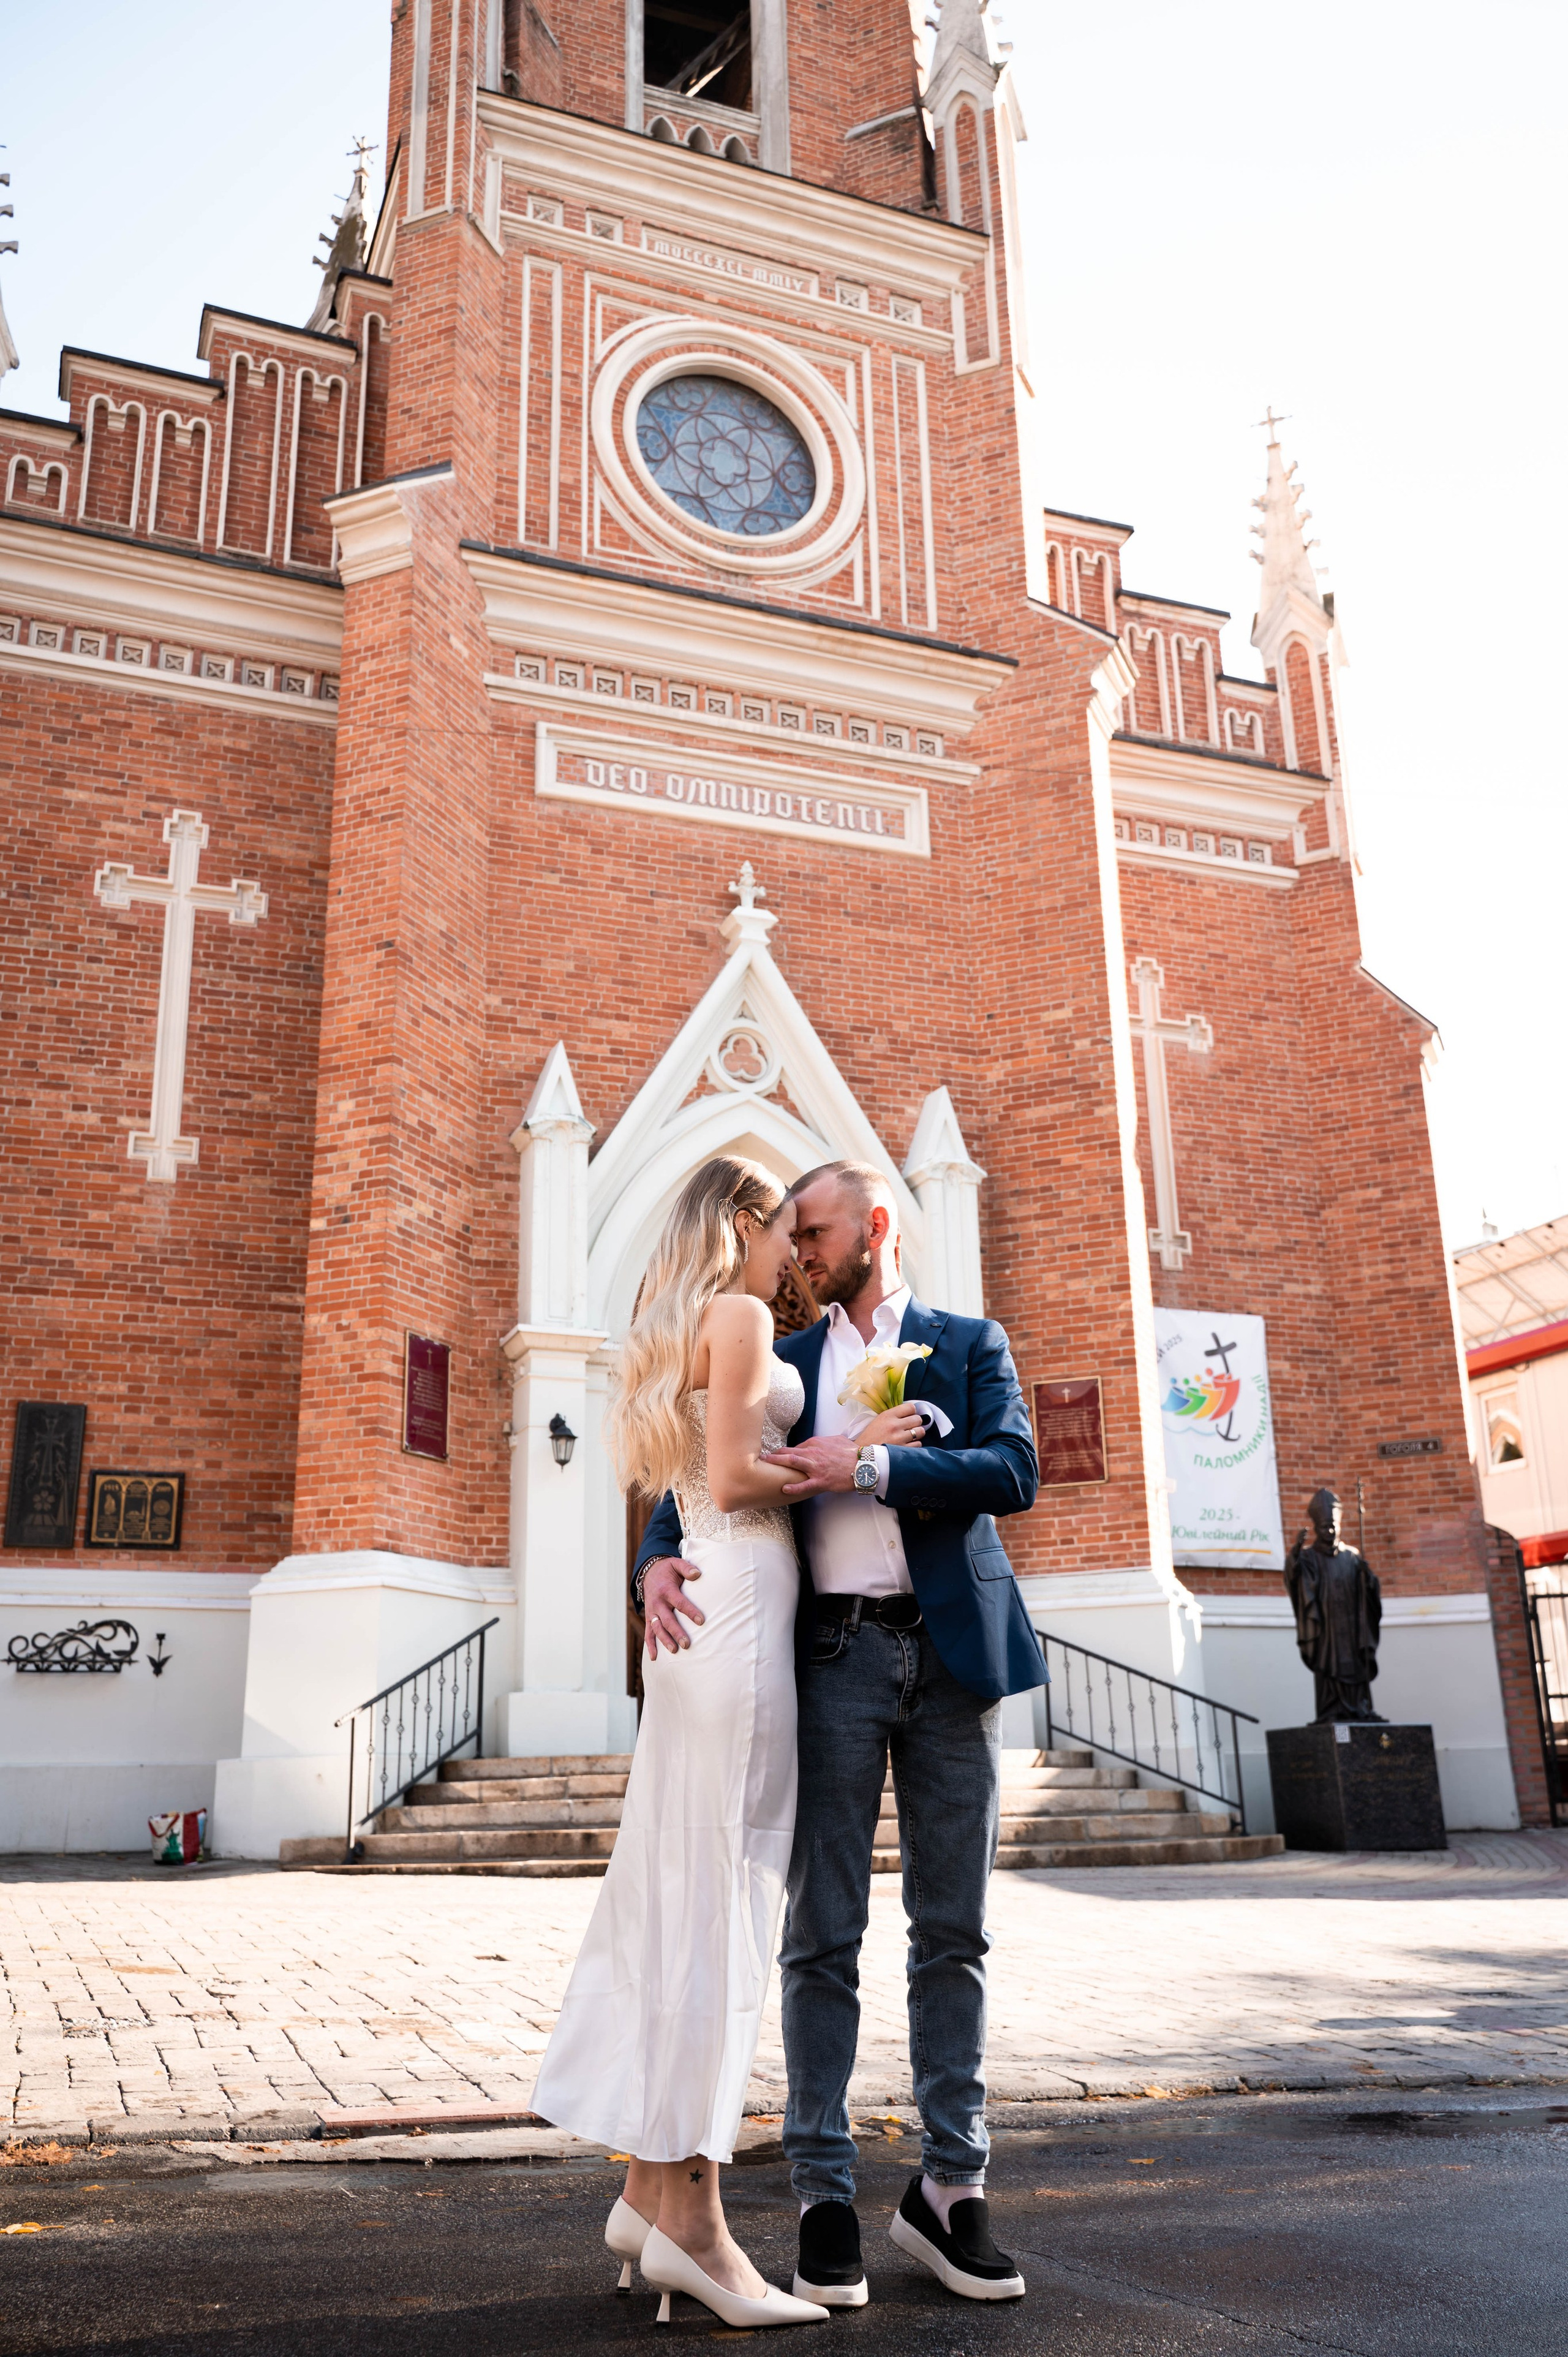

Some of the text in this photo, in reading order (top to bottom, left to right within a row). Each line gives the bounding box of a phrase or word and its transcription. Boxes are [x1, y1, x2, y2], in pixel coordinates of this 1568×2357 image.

[584, 759, 884, 834] DEO OMNIPOTENTI
[1194, 1419, 1267, 1469] ПАЛОМНИКИ
[1199, 1508, 1234, 1521] 2025
[1171, 1525, 1270, 1542] Ювілейний Рік
